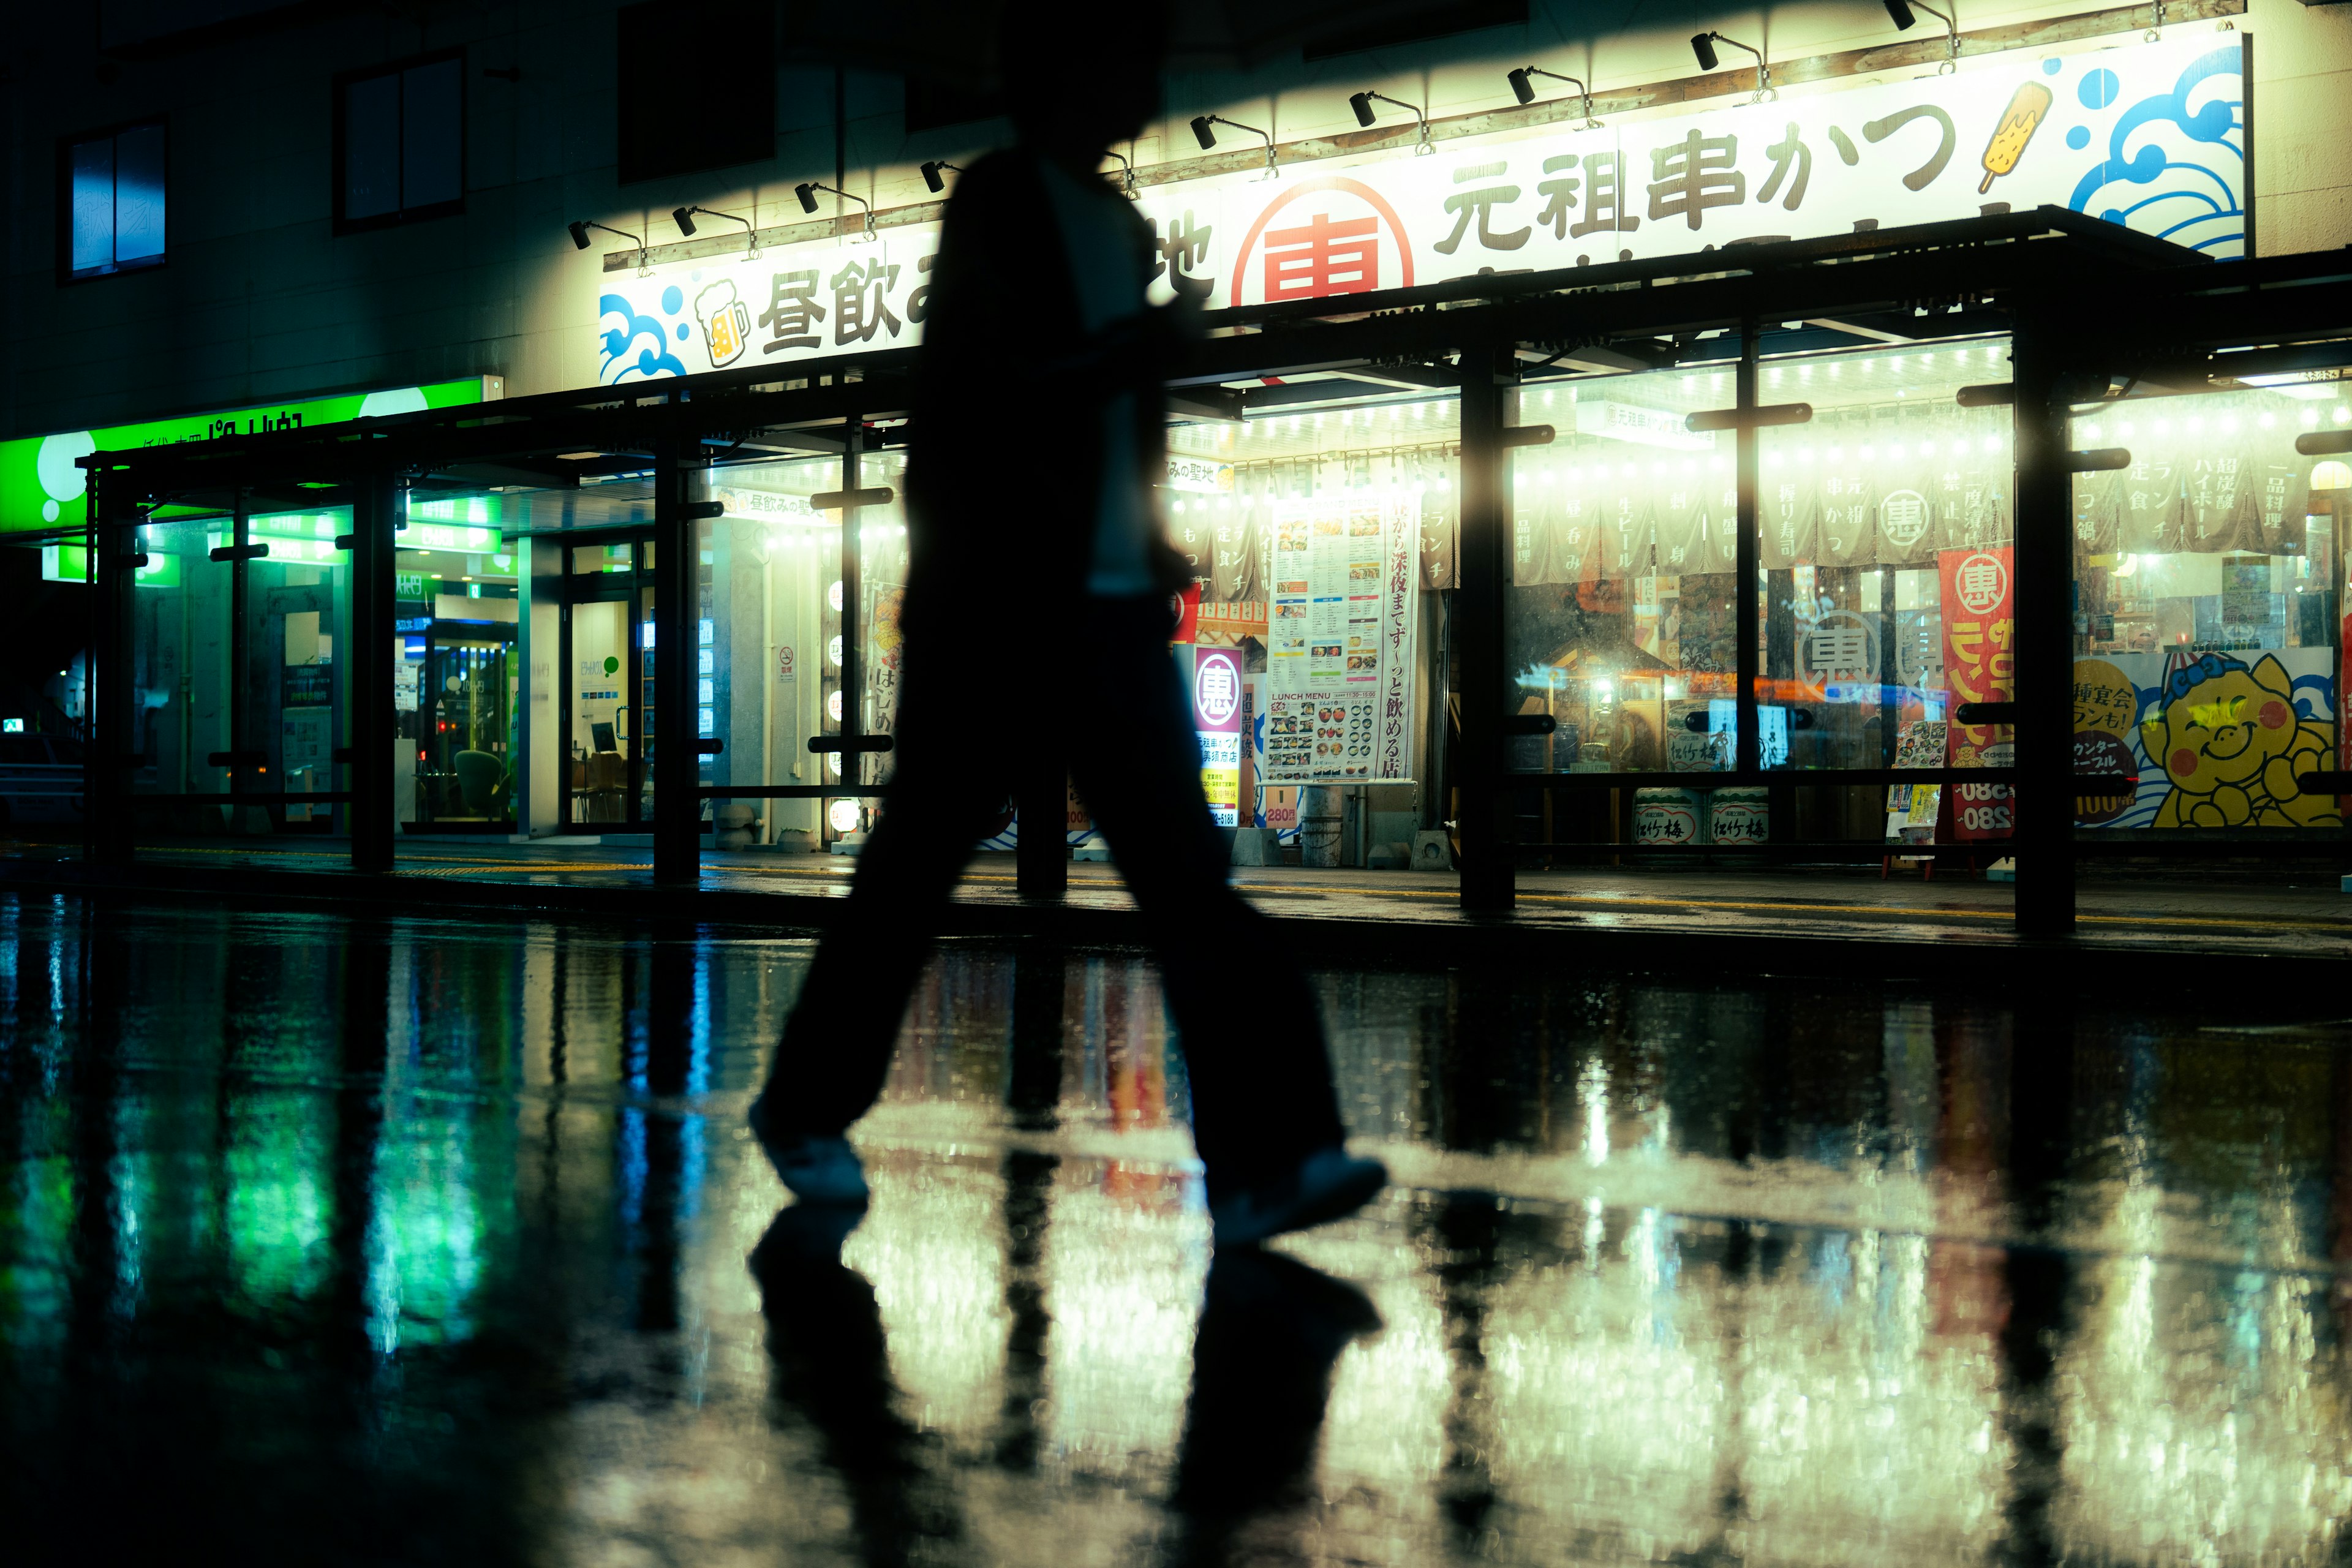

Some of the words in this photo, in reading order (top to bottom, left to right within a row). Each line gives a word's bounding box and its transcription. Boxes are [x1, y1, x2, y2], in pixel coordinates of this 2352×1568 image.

[1433, 104, 1956, 255] 元祖串かつ
[1308, 500, 1345, 511] GRAND
[1349, 498, 1379, 509] MENU
[1825, 477, 1842, 552] 串かつ
[1847, 478, 1864, 524] 元祖
[2129, 460, 2149, 510] 定食
[2152, 461, 2171, 540] ランチ
[2193, 459, 2212, 539] ハイボール
[2217, 458, 2237, 510] 超炭酸
[2264, 465, 2288, 528] 一品料理
[1218, 527, 1231, 567] 定食
[1429, 511, 1444, 578] ランチ
[1516, 508, 1530, 564] 一品料理
[1566, 499, 1580, 570] 昼呑み
[1617, 497, 1633, 568] 生ビール
[1670, 492, 1686, 564] 刺身
[1779, 484, 1795, 557] 握り寿司
[1232, 527, 1246, 590] ランチ
[1259, 525, 1272, 591] ハイボール
[875, 668, 894, 785] はじめした
[1636, 819, 1684, 838] 松竹梅
[1714, 816, 1766, 838] 松竹梅
